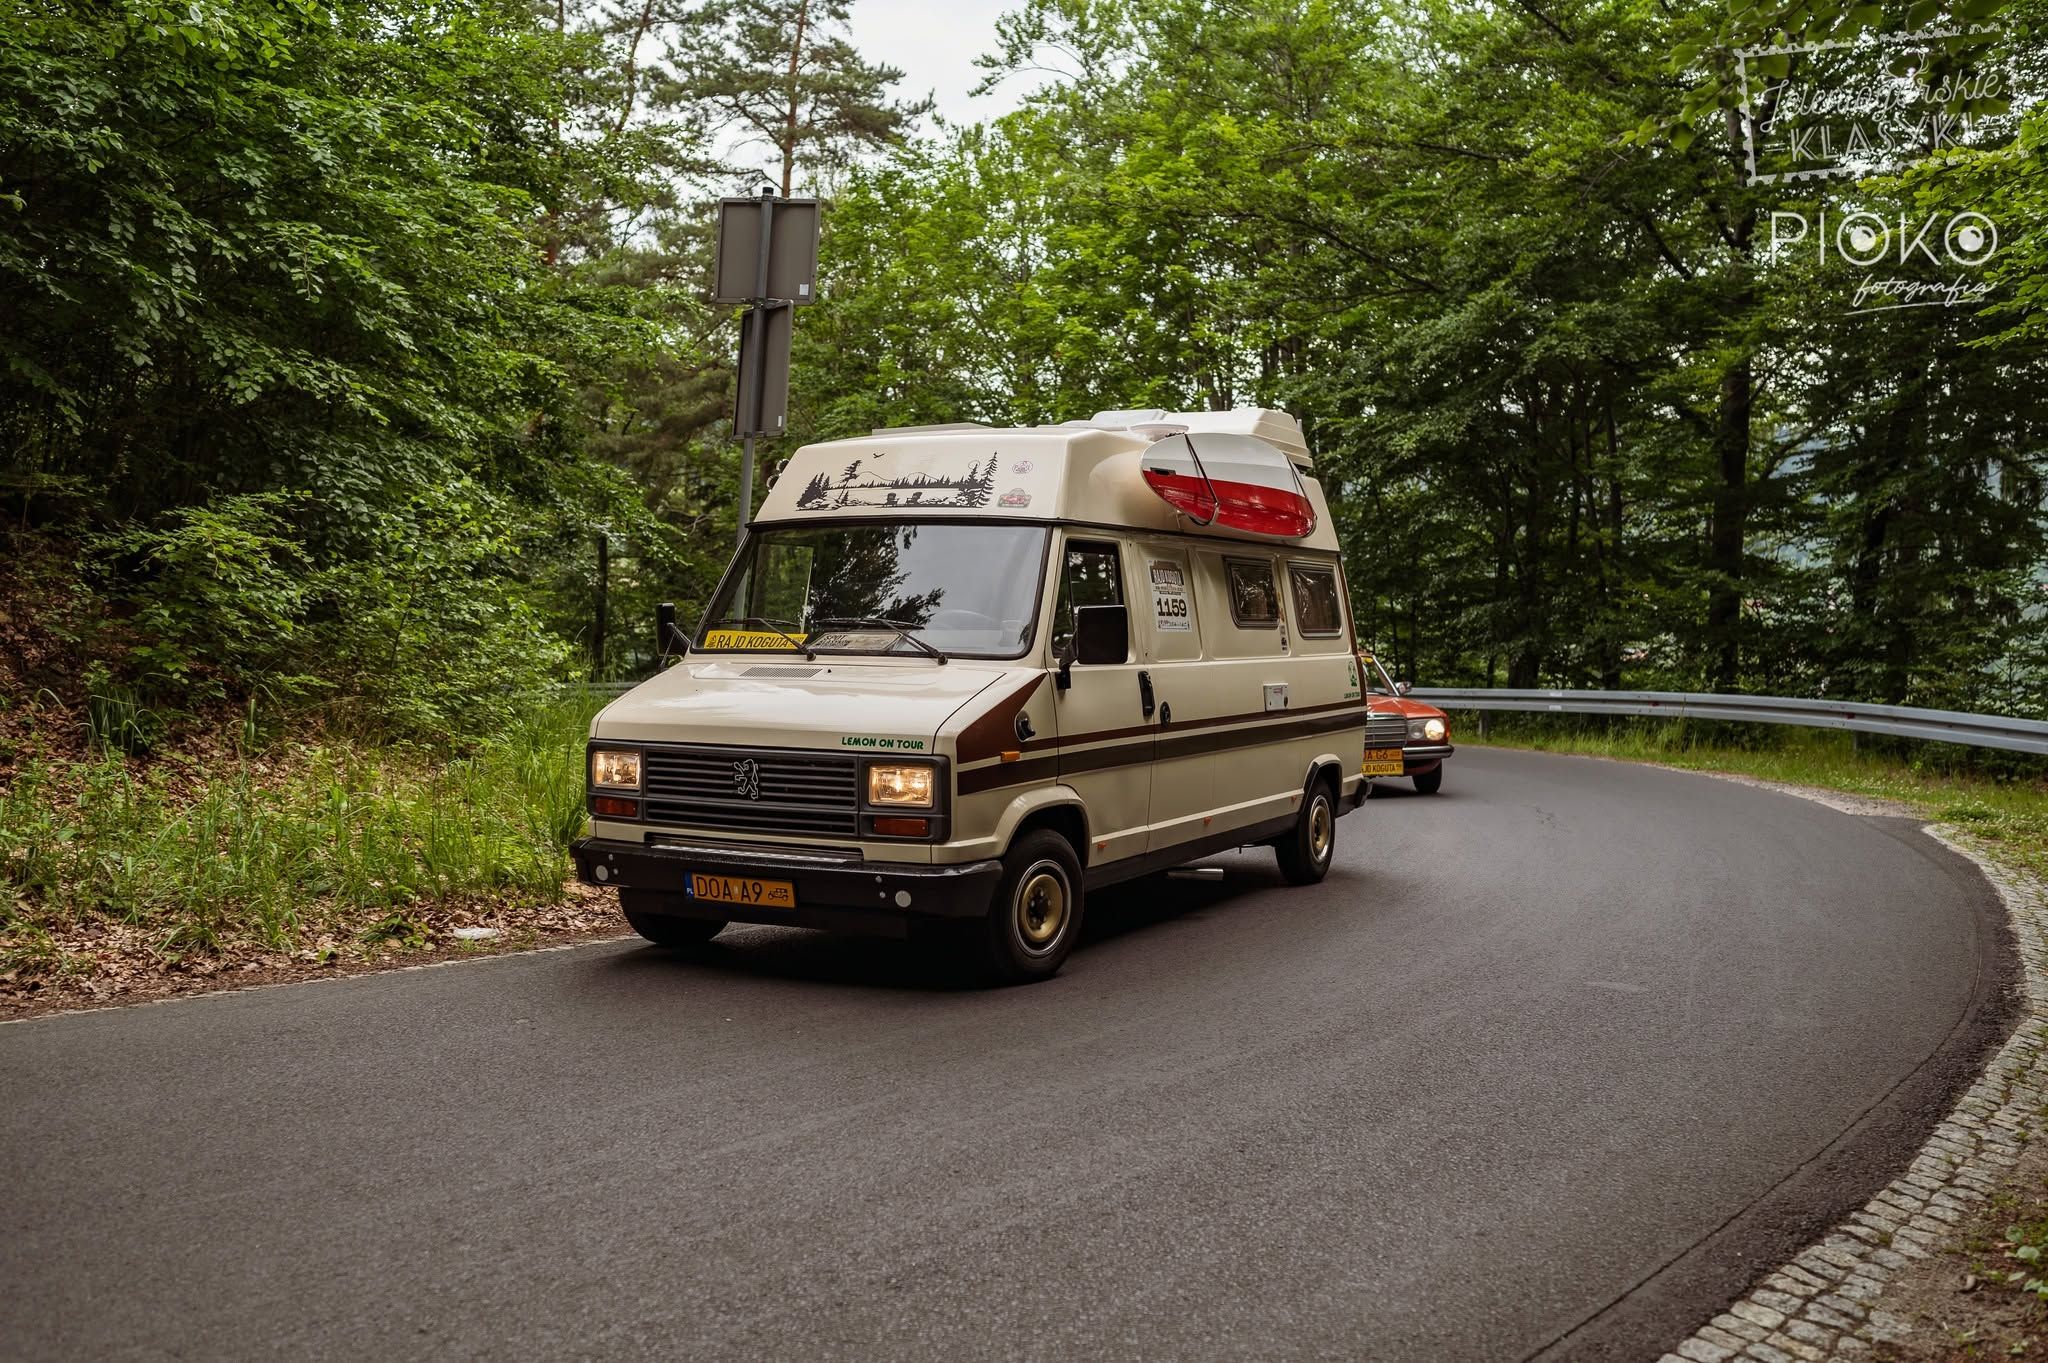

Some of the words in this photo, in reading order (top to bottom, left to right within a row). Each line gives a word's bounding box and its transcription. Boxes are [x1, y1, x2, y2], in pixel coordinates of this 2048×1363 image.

[1157, 598, 1187, 617] 1159
[716, 635, 747, 648] RAJD
[745, 636, 790, 648] KOGUTA
[842, 737, 876, 747] LEMON
[879, 739, 894, 748] ON
[897, 740, 924, 750] TOUR
[1376, 751, 1388, 760] G6
[1372, 763, 1396, 773] KOGUTA
[696, 877, 733, 900] DOA
[741, 881, 762, 902] A9
